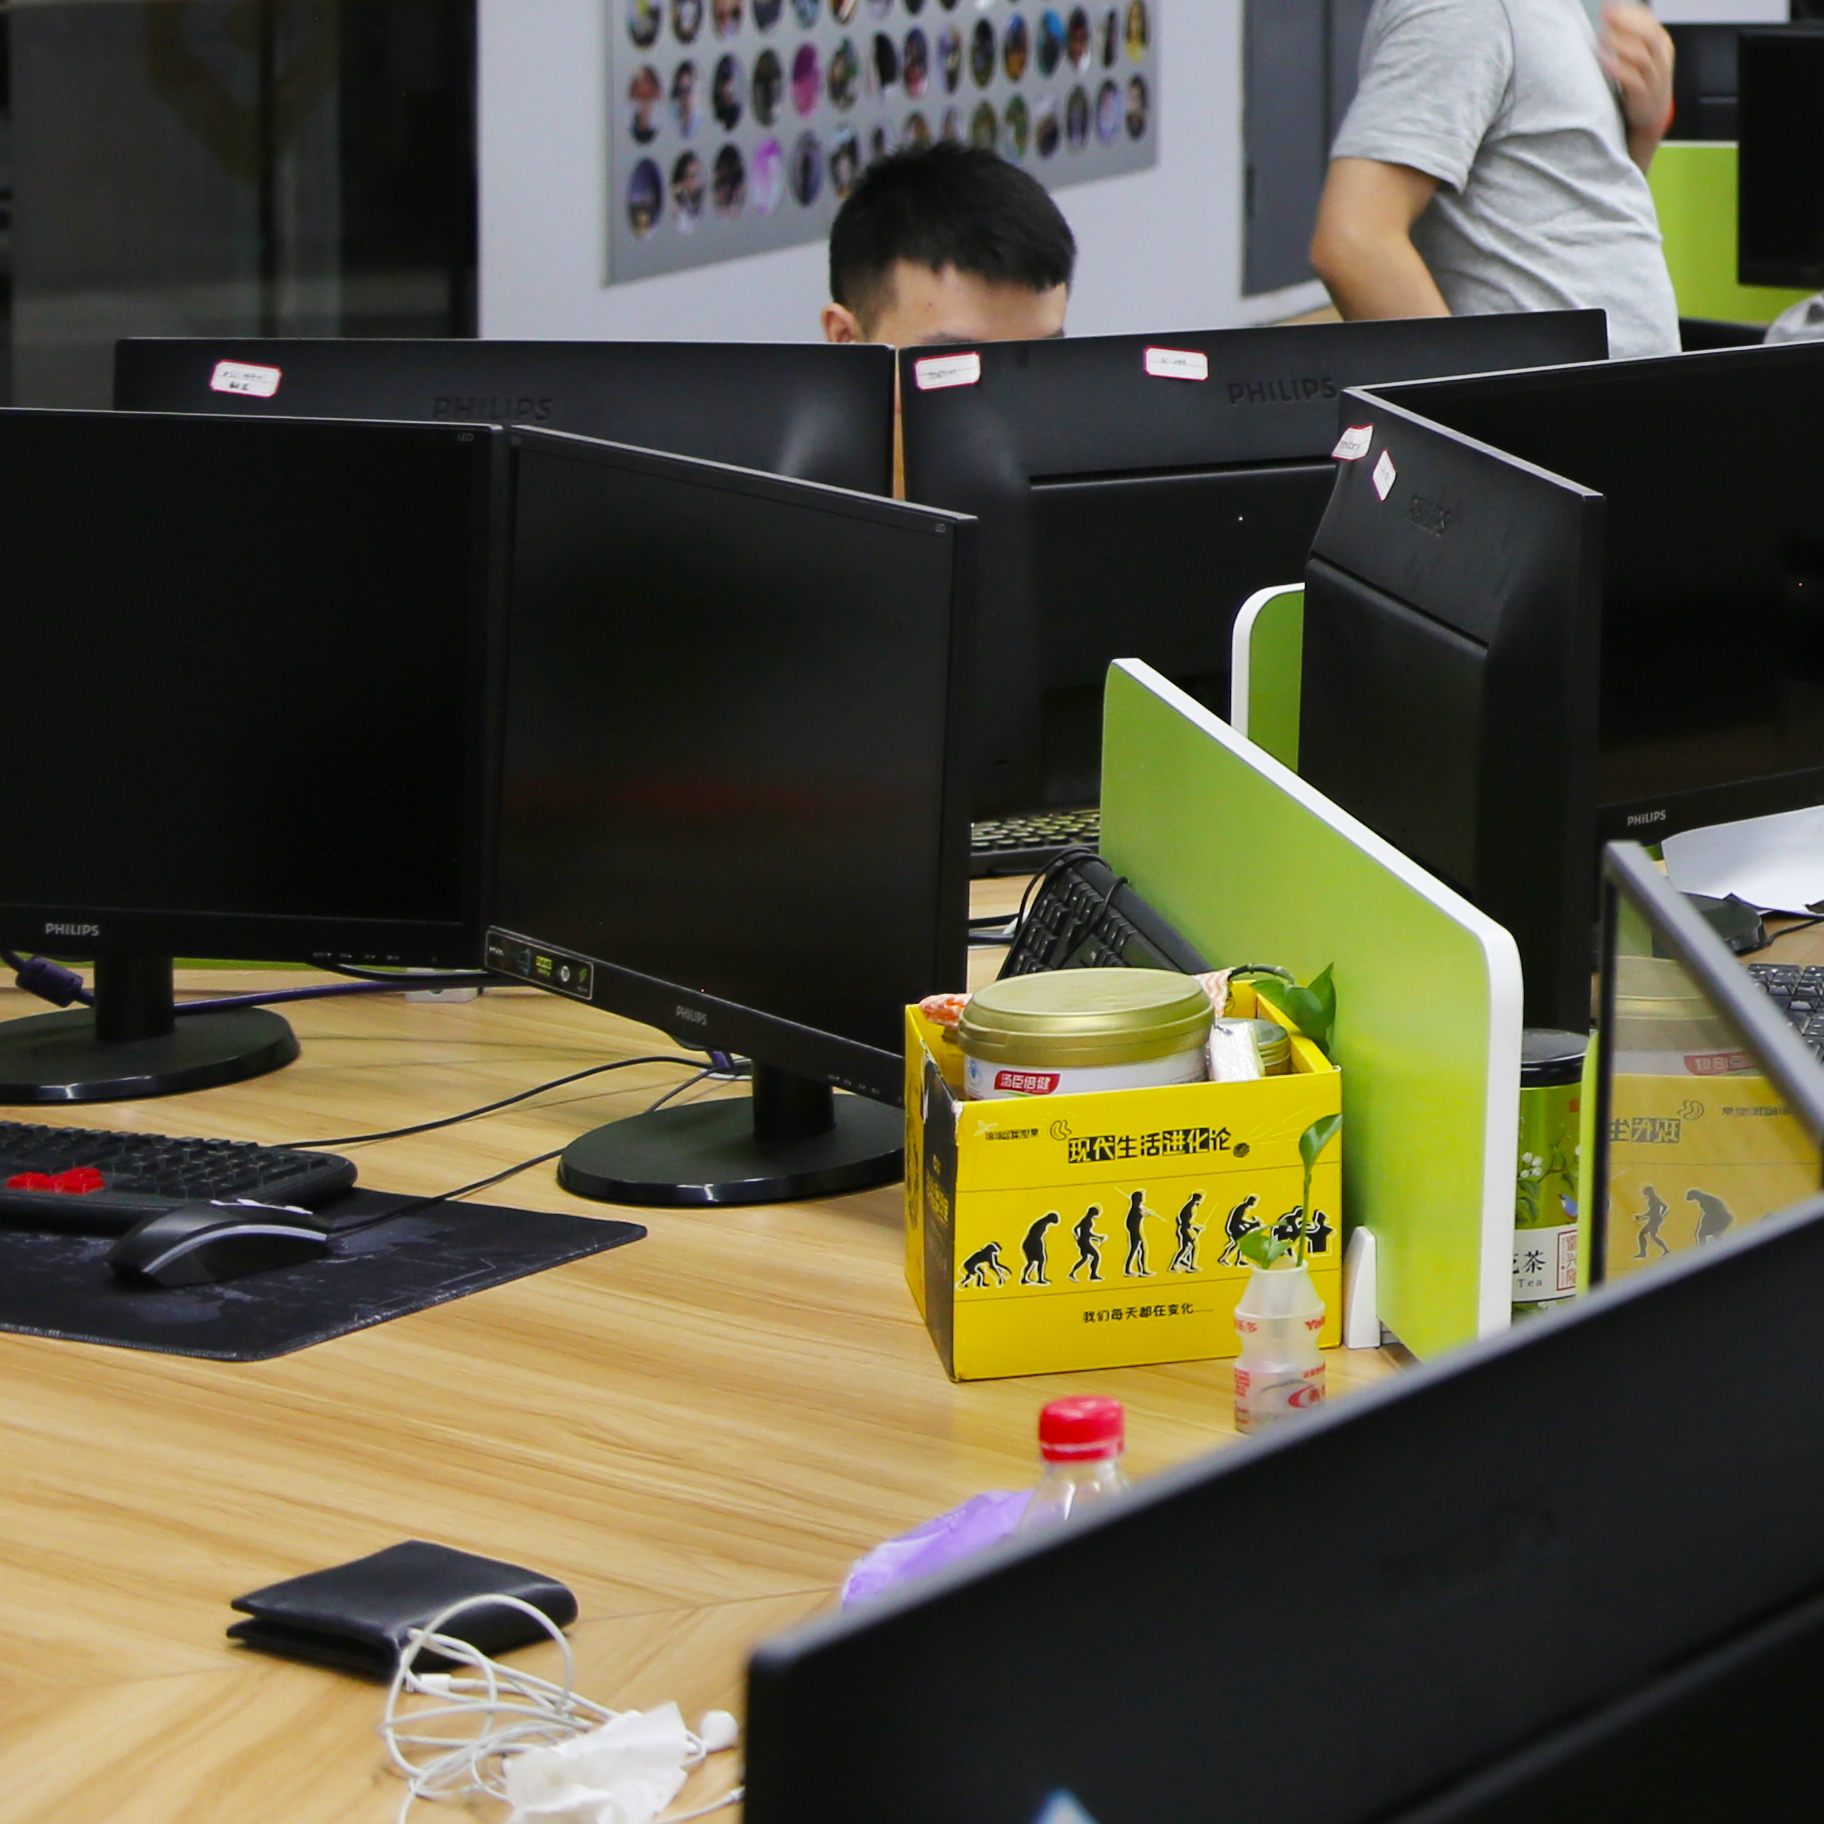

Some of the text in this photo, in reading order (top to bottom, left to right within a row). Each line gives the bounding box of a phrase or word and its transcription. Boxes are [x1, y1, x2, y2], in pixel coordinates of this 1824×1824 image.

[1227, 377, 1337, 404] PHILIPS
[433, 396, 553, 421] PHILIPS
[45, 922, 100, 938] PHILIPS
[676, 1005, 708, 1026] PHILIPS
[1000, 1072, 1051, 1091] 汤臣倍健
[1068, 1127, 1232, 1164] 现代生活进化论
[1517, 1278, 1543, 1288] Tea
